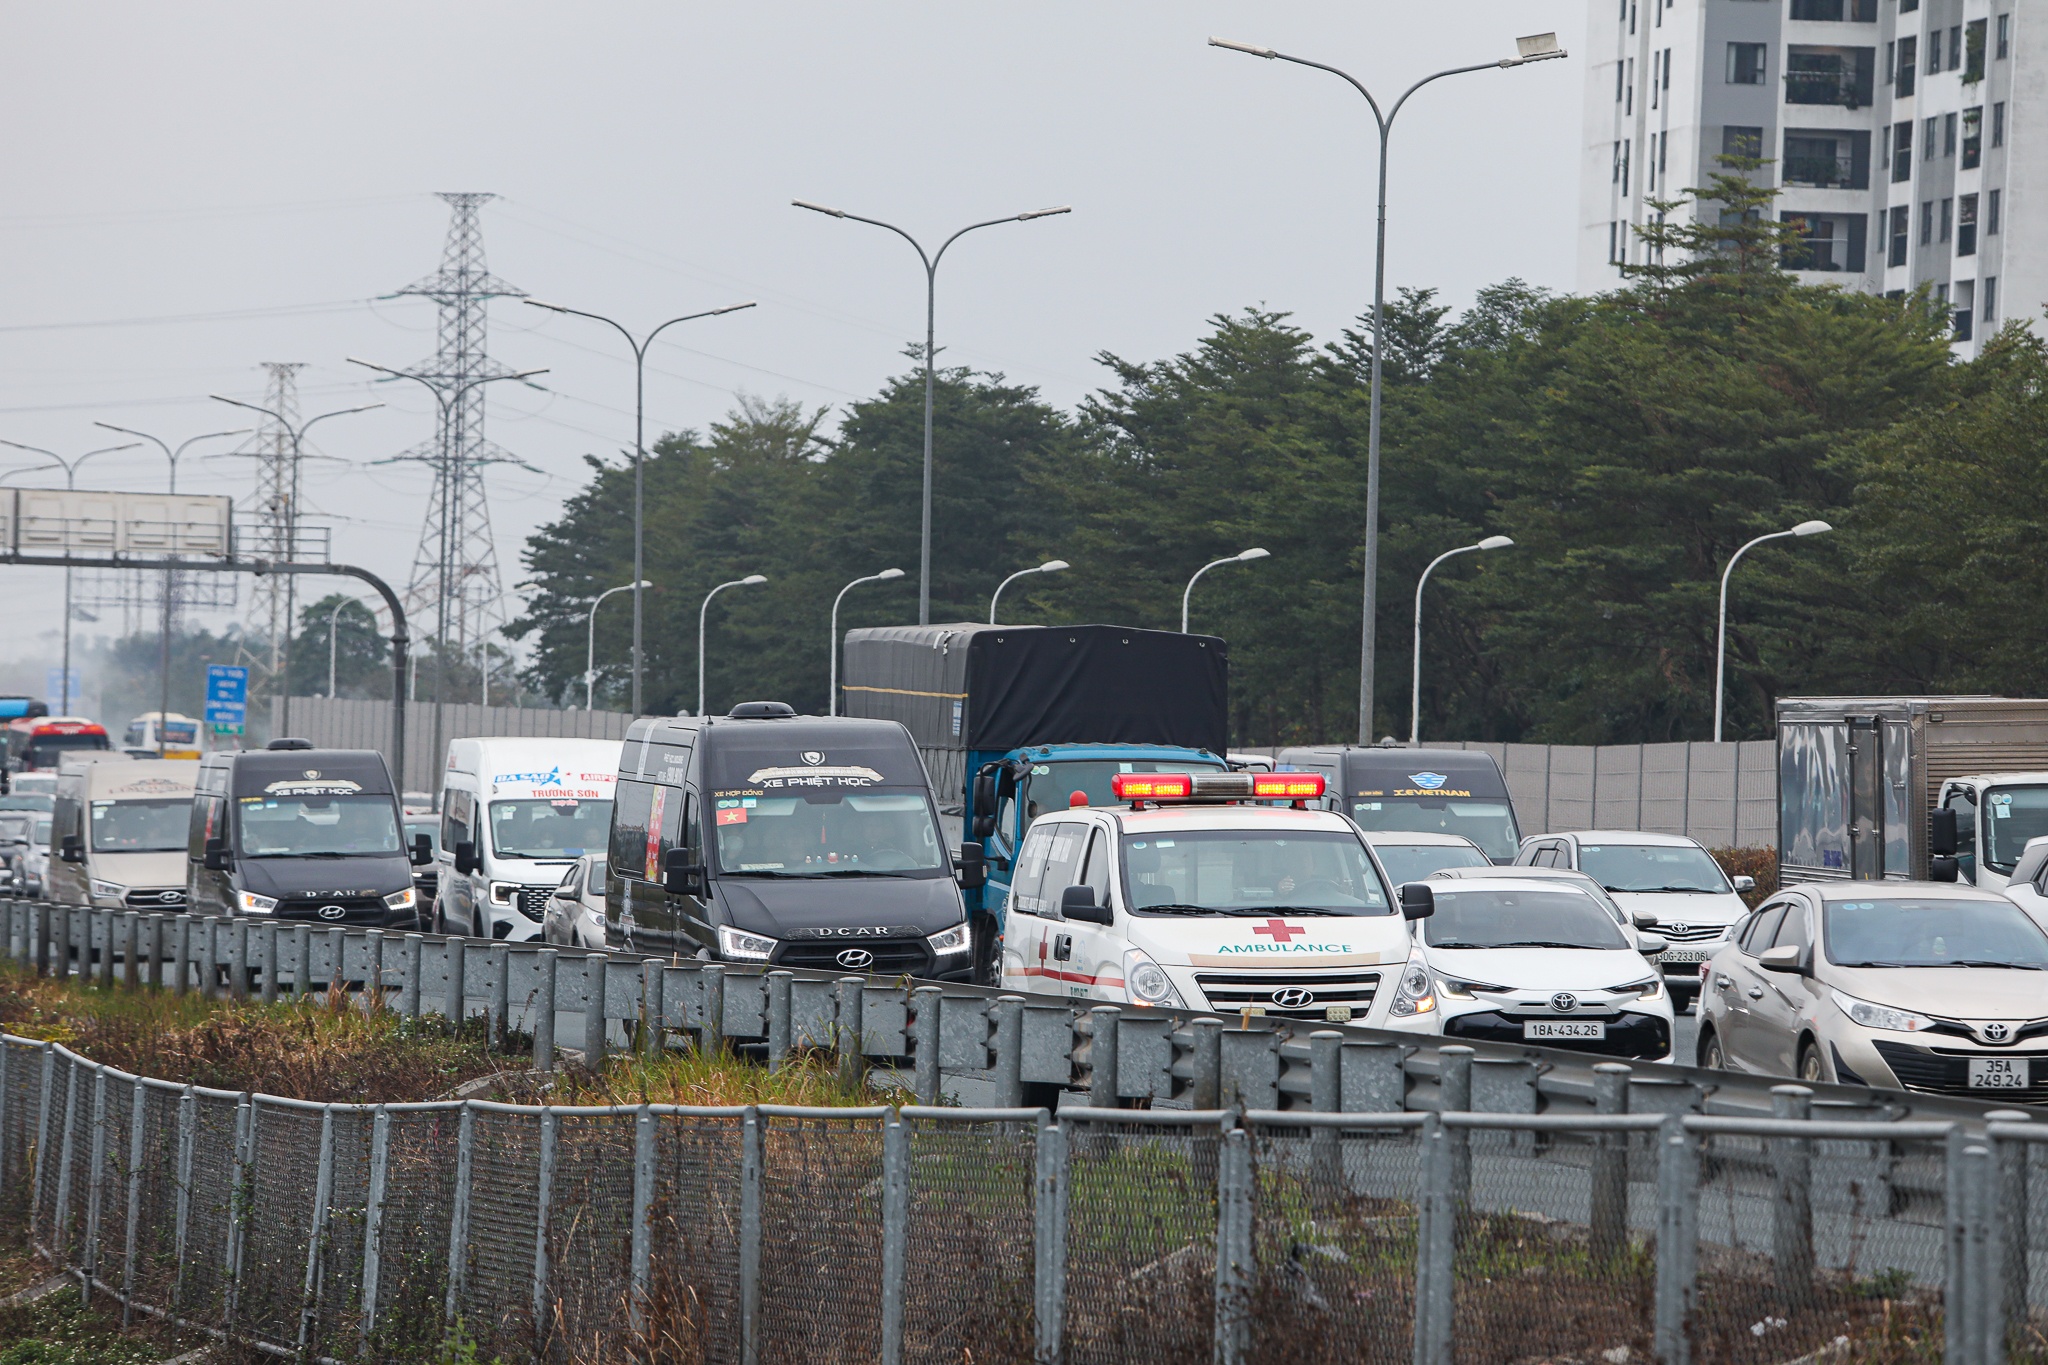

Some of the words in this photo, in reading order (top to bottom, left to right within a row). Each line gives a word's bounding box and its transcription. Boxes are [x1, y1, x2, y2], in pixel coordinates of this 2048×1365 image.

[762, 779, 784, 788] XE
[787, 775, 834, 787] PHIỆT
[838, 777, 872, 787] HỌC
[275, 788, 291, 796] XE
[293, 786, 326, 795] PHIỆT
[328, 787, 354, 796] HỌC
[577, 789, 599, 798] SƠN
[819, 926, 889, 936] DCAR
[1218, 944, 1353, 953] AMBULANCE
[1532, 1024, 1599, 1036] 18A-434.26
[1986, 1060, 2012, 1073] 35A
[1975, 1074, 2023, 1087] 249.24
